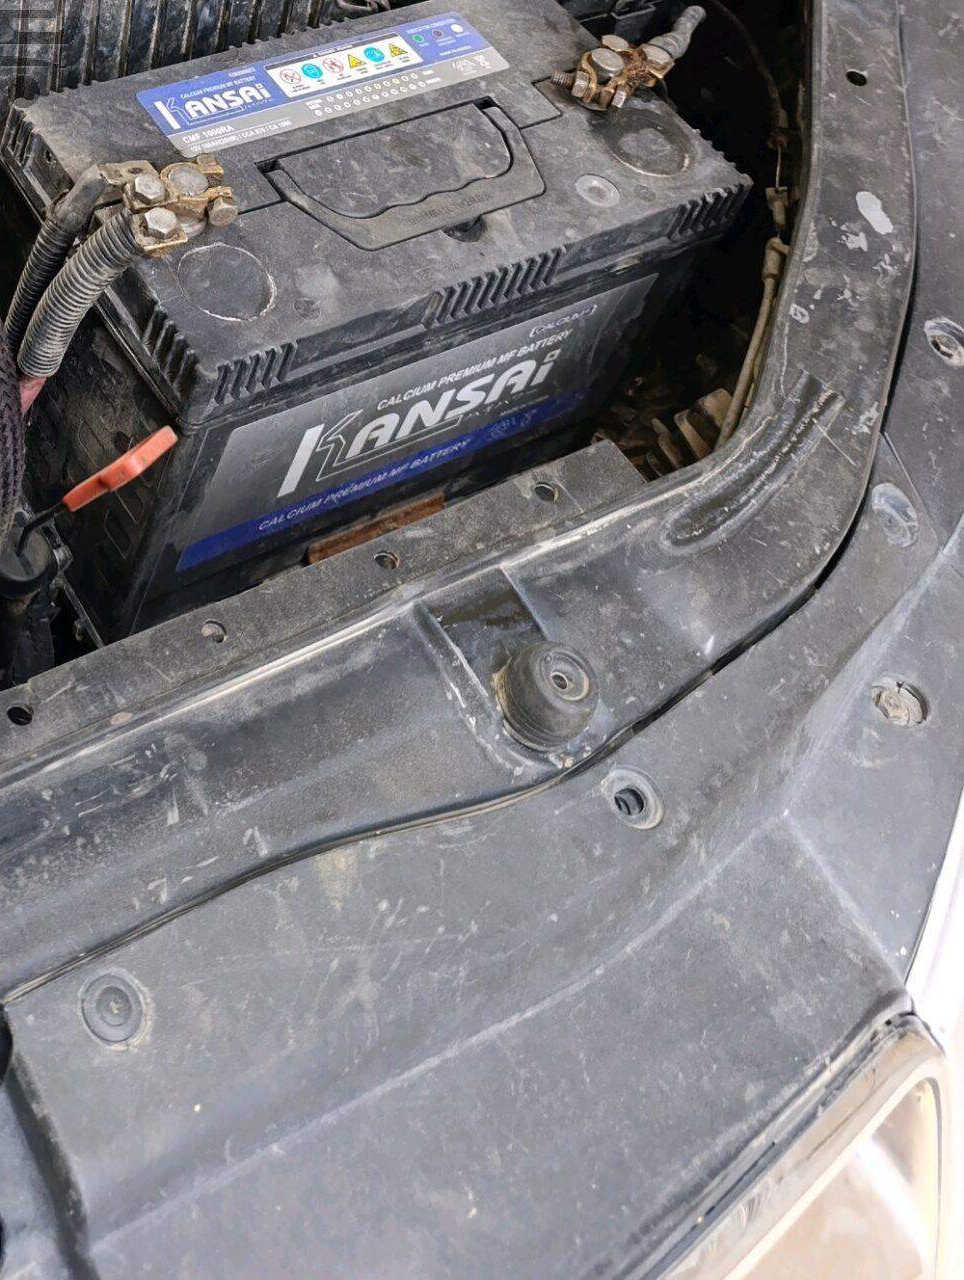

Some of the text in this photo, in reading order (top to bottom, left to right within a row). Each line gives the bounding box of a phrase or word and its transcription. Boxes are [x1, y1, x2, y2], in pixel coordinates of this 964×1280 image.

[377, 379, 438, 411] CALCIUM
[436, 356, 498, 388] PREMIUM
[496, 349, 518, 366] MF
[516, 328, 573, 358] BATTERY
[258, 438, 471, 531] CALCIUM PREMIUM MF BATTERY
